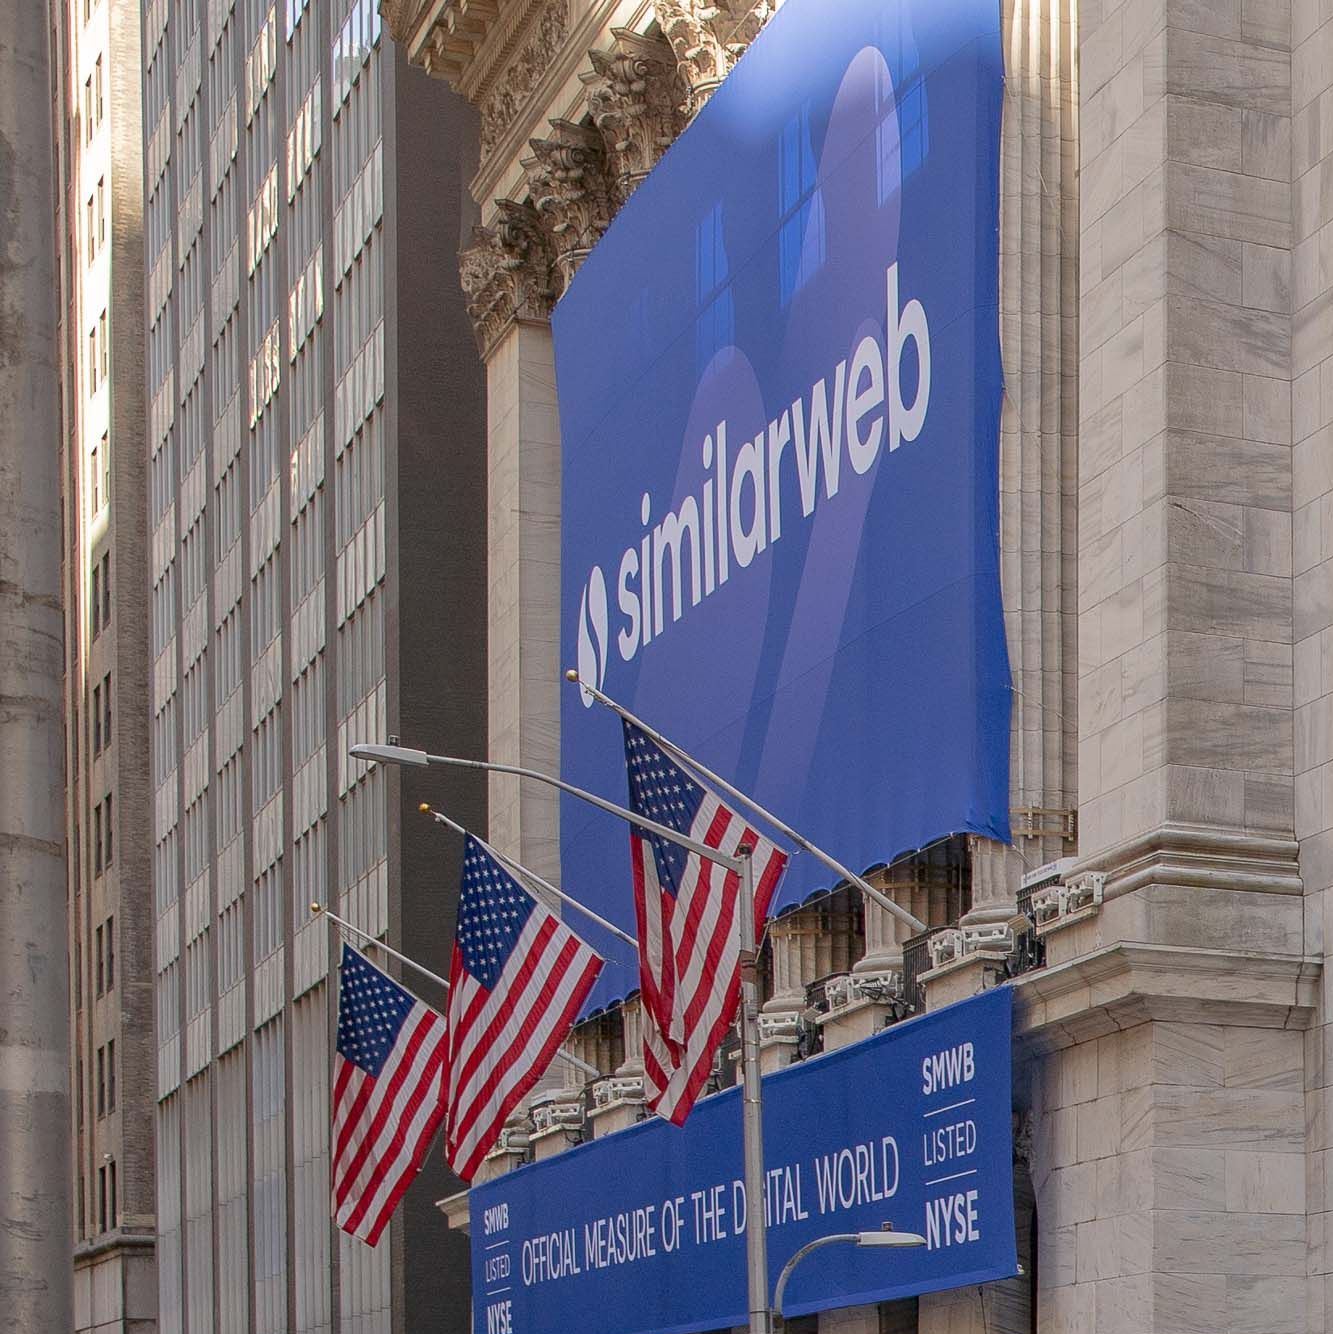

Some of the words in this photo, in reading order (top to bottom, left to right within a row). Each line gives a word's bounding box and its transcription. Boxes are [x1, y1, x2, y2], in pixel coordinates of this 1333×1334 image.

[618, 261, 931, 661] similarweb
[922, 1042, 975, 1095] SMWB
[923, 1120, 977, 1166] LISTED
[484, 1203, 509, 1236] SMWB
[522, 1228, 581, 1286] OFFICIAL
[584, 1205, 656, 1271] MEASURE
[661, 1196, 685, 1252] OF
[691, 1185, 727, 1245] THE
[733, 1163, 809, 1235] DITAL
[815, 1136, 899, 1215] WORLD
[925, 1190, 980, 1250] NYSE
[485, 1254, 511, 1283] LISTED
